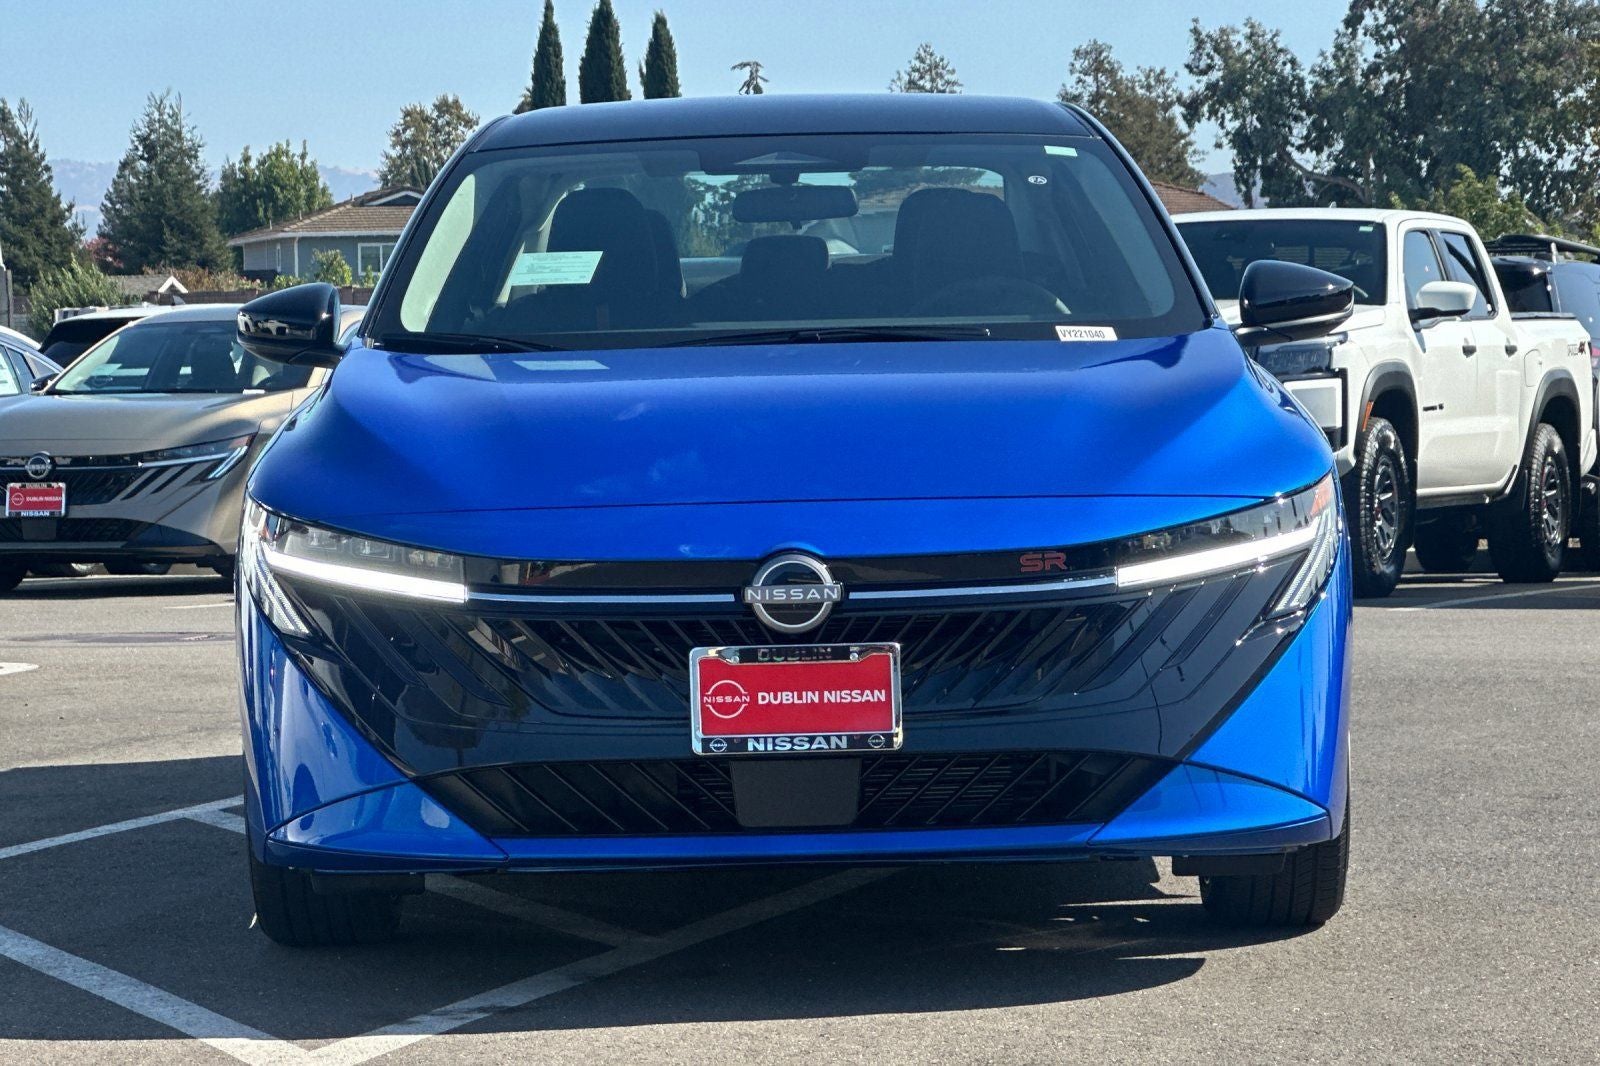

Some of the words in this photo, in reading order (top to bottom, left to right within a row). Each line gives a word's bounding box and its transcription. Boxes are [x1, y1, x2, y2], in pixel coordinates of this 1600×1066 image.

[1059, 328, 1106, 339] VY221040
[1020, 552, 1068, 572] SR
[747, 587, 838, 601] NISSAN
[703, 695, 750, 703] NISSAN
[757, 690, 820, 705] DUBLIN
[823, 689, 886, 703] NISSAN
[747, 736, 848, 751] NISSAN
